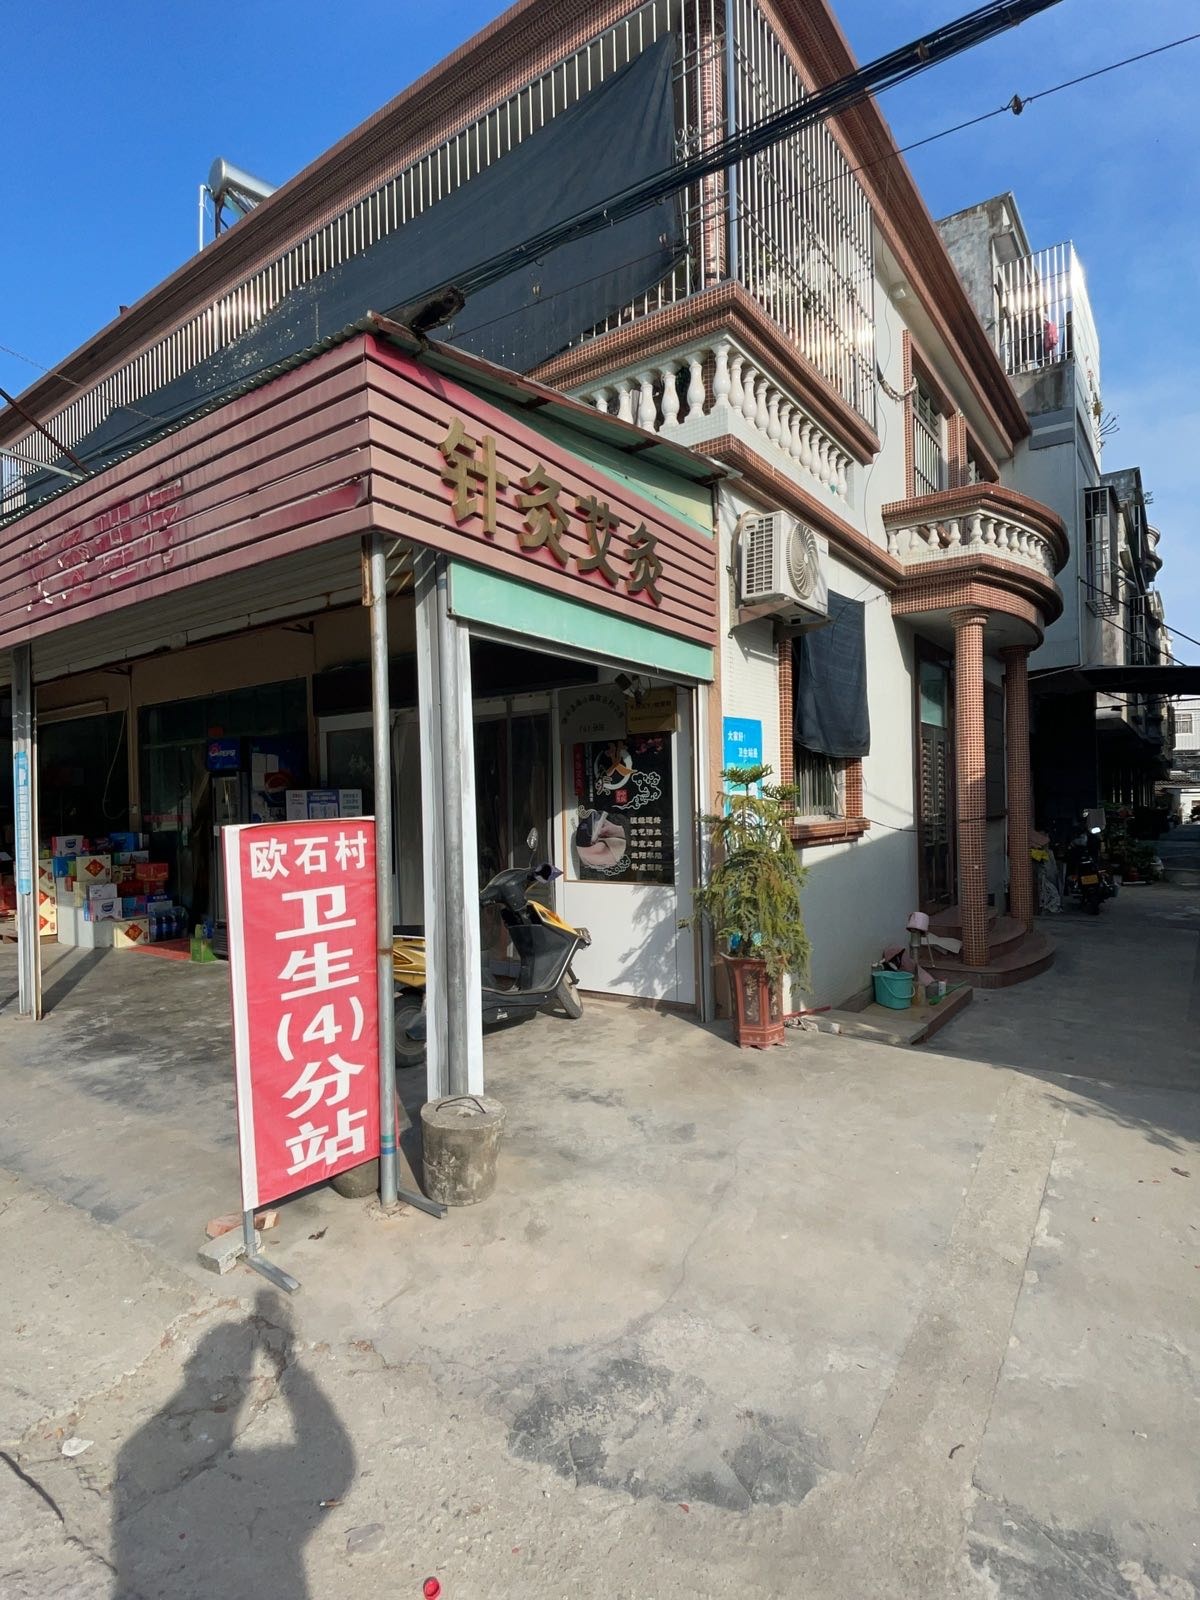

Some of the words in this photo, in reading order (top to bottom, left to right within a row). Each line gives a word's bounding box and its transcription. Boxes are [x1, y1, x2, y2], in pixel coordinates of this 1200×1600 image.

[438, 416, 664, 607] 针灸艾灸
[249, 830, 368, 881] 欧石村
[275, 885, 366, 1176] 卫生(4)分站
